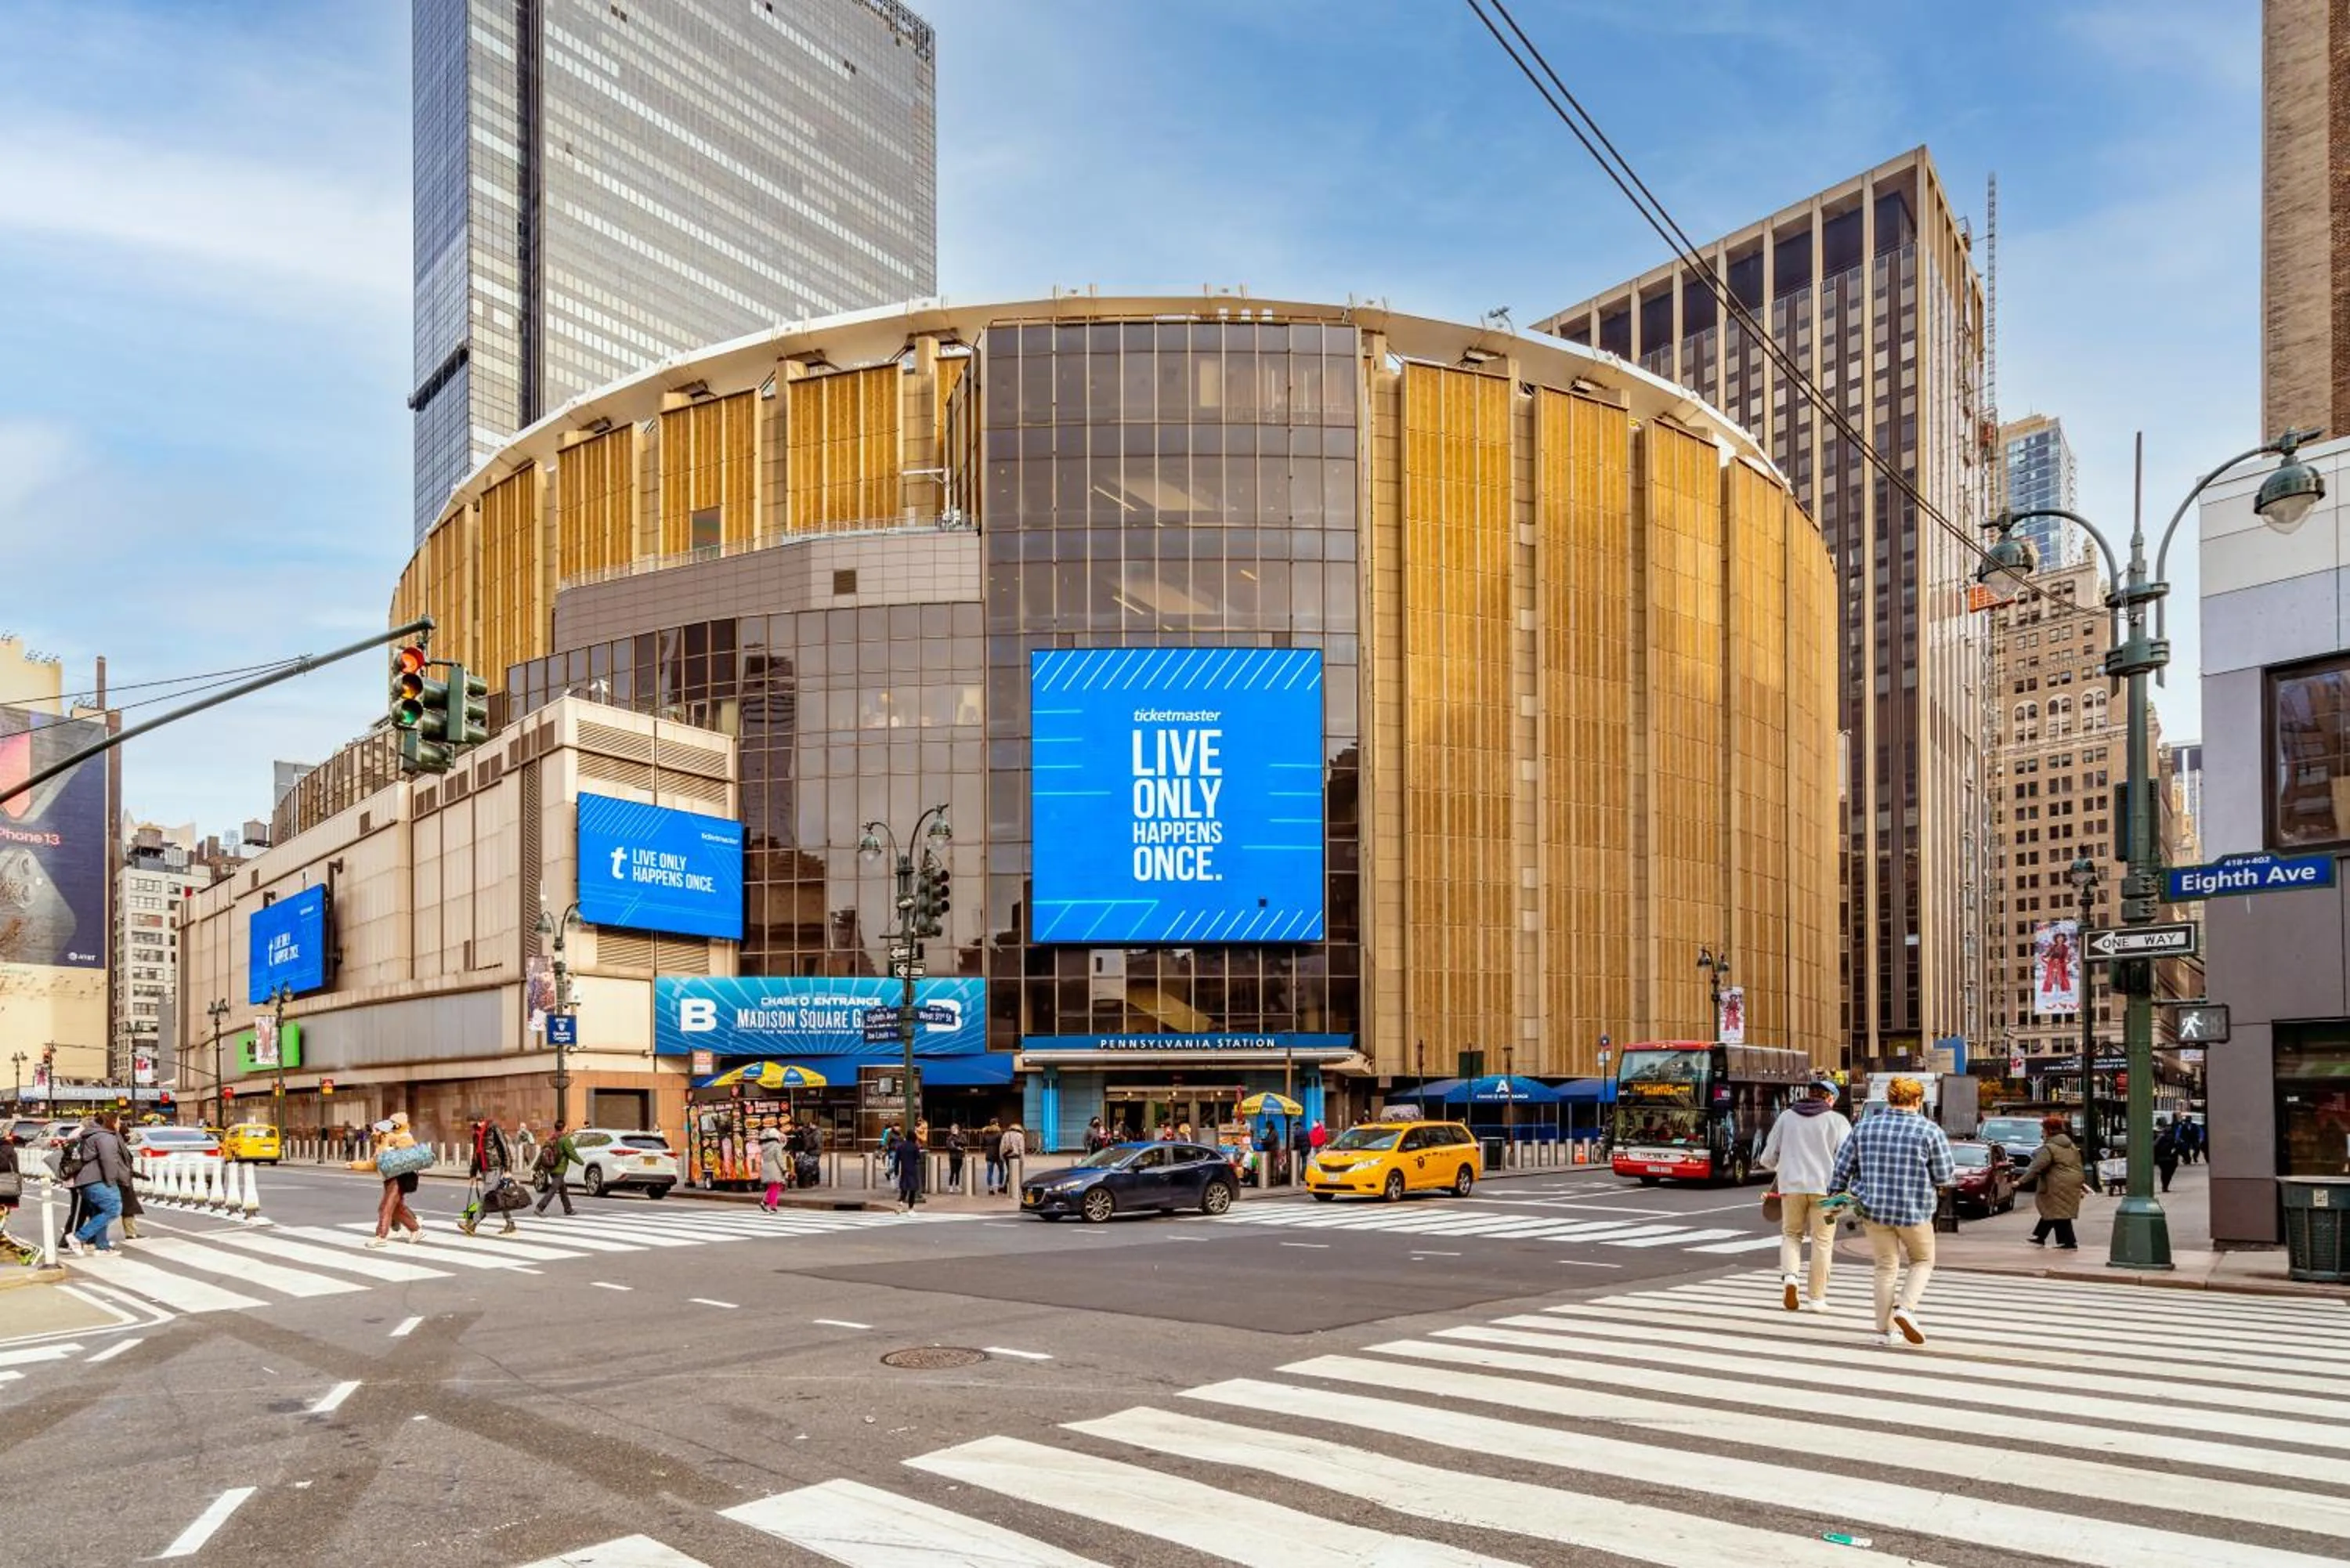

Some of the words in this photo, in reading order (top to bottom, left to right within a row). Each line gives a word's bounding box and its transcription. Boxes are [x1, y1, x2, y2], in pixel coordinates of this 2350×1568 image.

[1133, 708, 1221, 721] ticketmaster
[1132, 729, 1223, 776] LIVE
[1133, 778, 1223, 819] ONLY
[1133, 822, 1223, 844] HAPPENS
[610, 846, 627, 880] t
[632, 847, 657, 867] LIVE
[659, 852, 687, 872] ONLY
[1133, 845, 1223, 882] ONCE.
[632, 865, 684, 888] HAPPENS
[685, 873, 717, 893] ONCE.
[2181, 869, 2258, 894] Eighth
[2266, 866, 2316, 883] Ave
[2102, 937, 2129, 948] ONE
[2144, 933, 2177, 945] WAY
[761, 997, 794, 1006] CHASE
[813, 997, 882, 1006] ENTRANCE
[680, 999, 717, 1031] B
[737, 1008, 795, 1028] MADISON
[800, 1008, 848, 1029] SQUARE
[1100, 1039, 1210, 1049] PENNSYLVANIA
[1217, 1038, 1275, 1048] STATION
[1495, 1079, 1509, 1093] A
